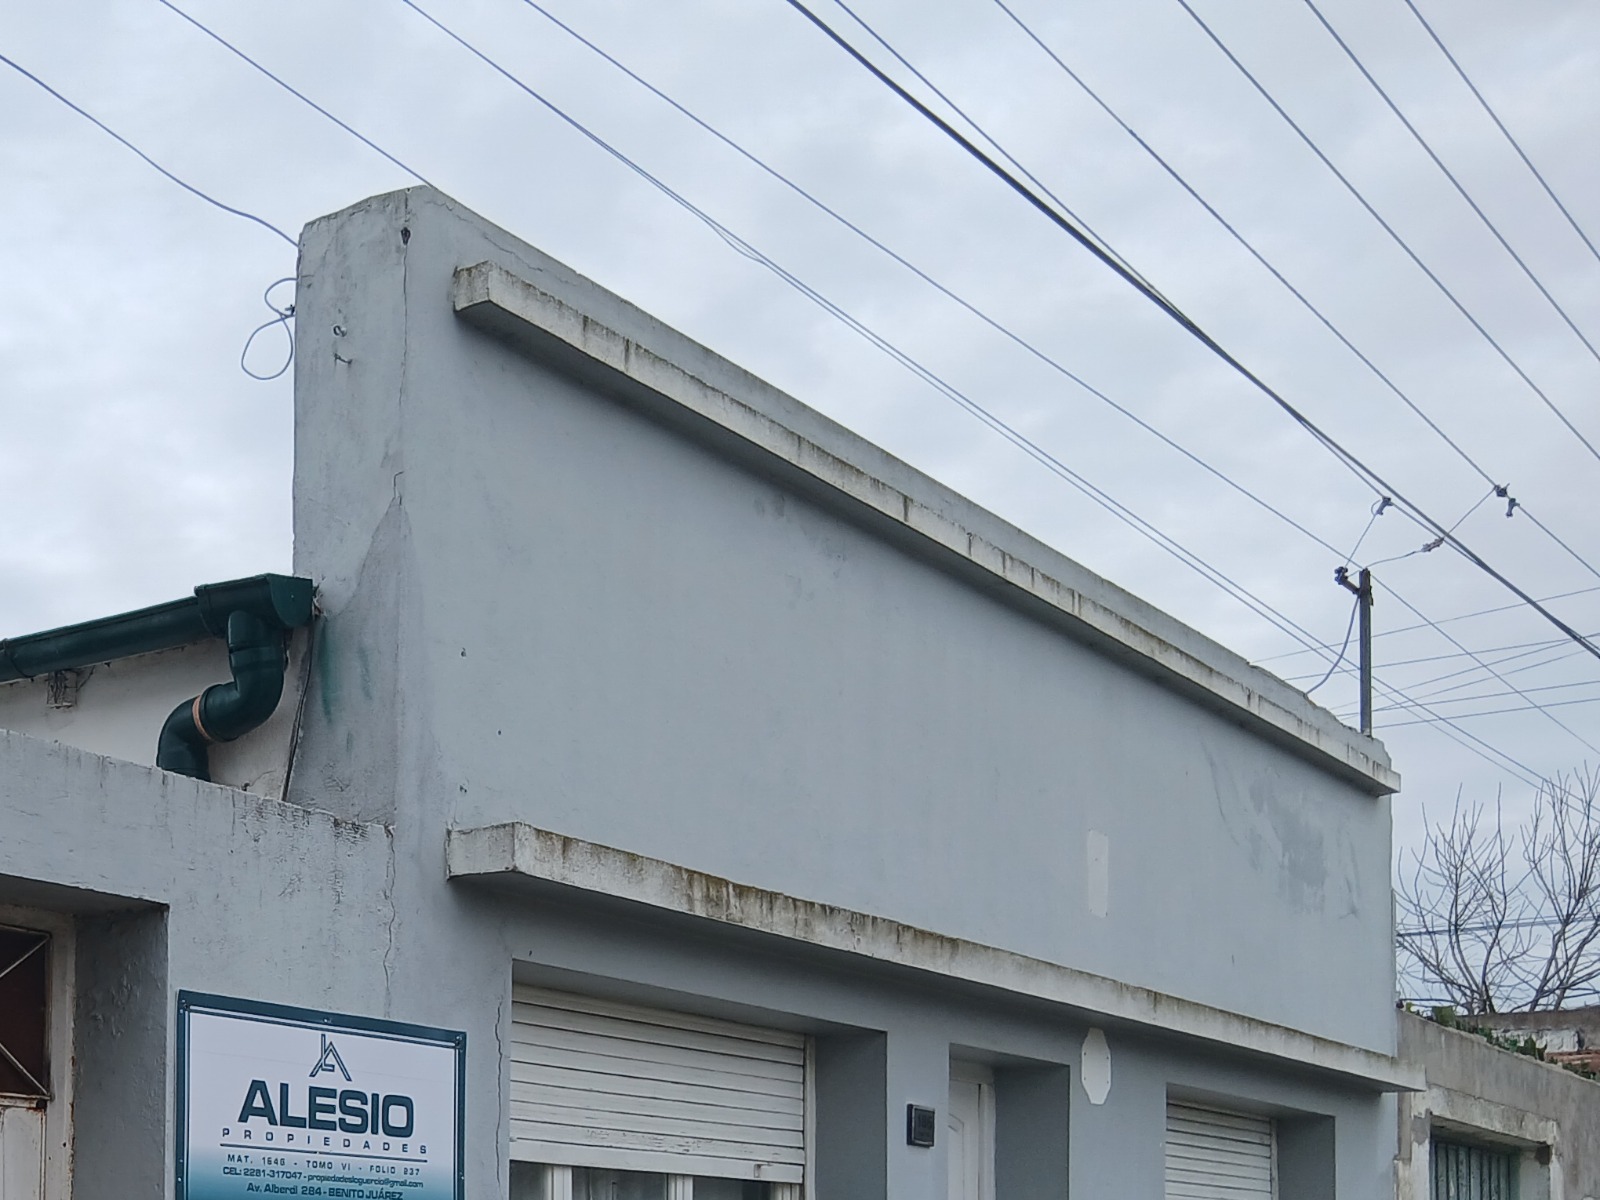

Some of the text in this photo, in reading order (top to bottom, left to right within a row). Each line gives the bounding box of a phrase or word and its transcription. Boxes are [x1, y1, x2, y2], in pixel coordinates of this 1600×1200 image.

[237, 1079, 414, 1138] ALESIO
[221, 1128, 427, 1154] PROPIEDADES
[222, 1166, 242, 1176] CEL:
[243, 1167, 303, 1179] 2281-317047
[227, 1153, 253, 1164] MAT.
[305, 1159, 333, 1170] TOMO
[341, 1162, 351, 1171] VI
[369, 1164, 397, 1175] FOLIO
[246, 1181, 262, 1193] Av.
[263, 1183, 298, 1195] Alberdi
[328, 1187, 364, 1199] BENITO
